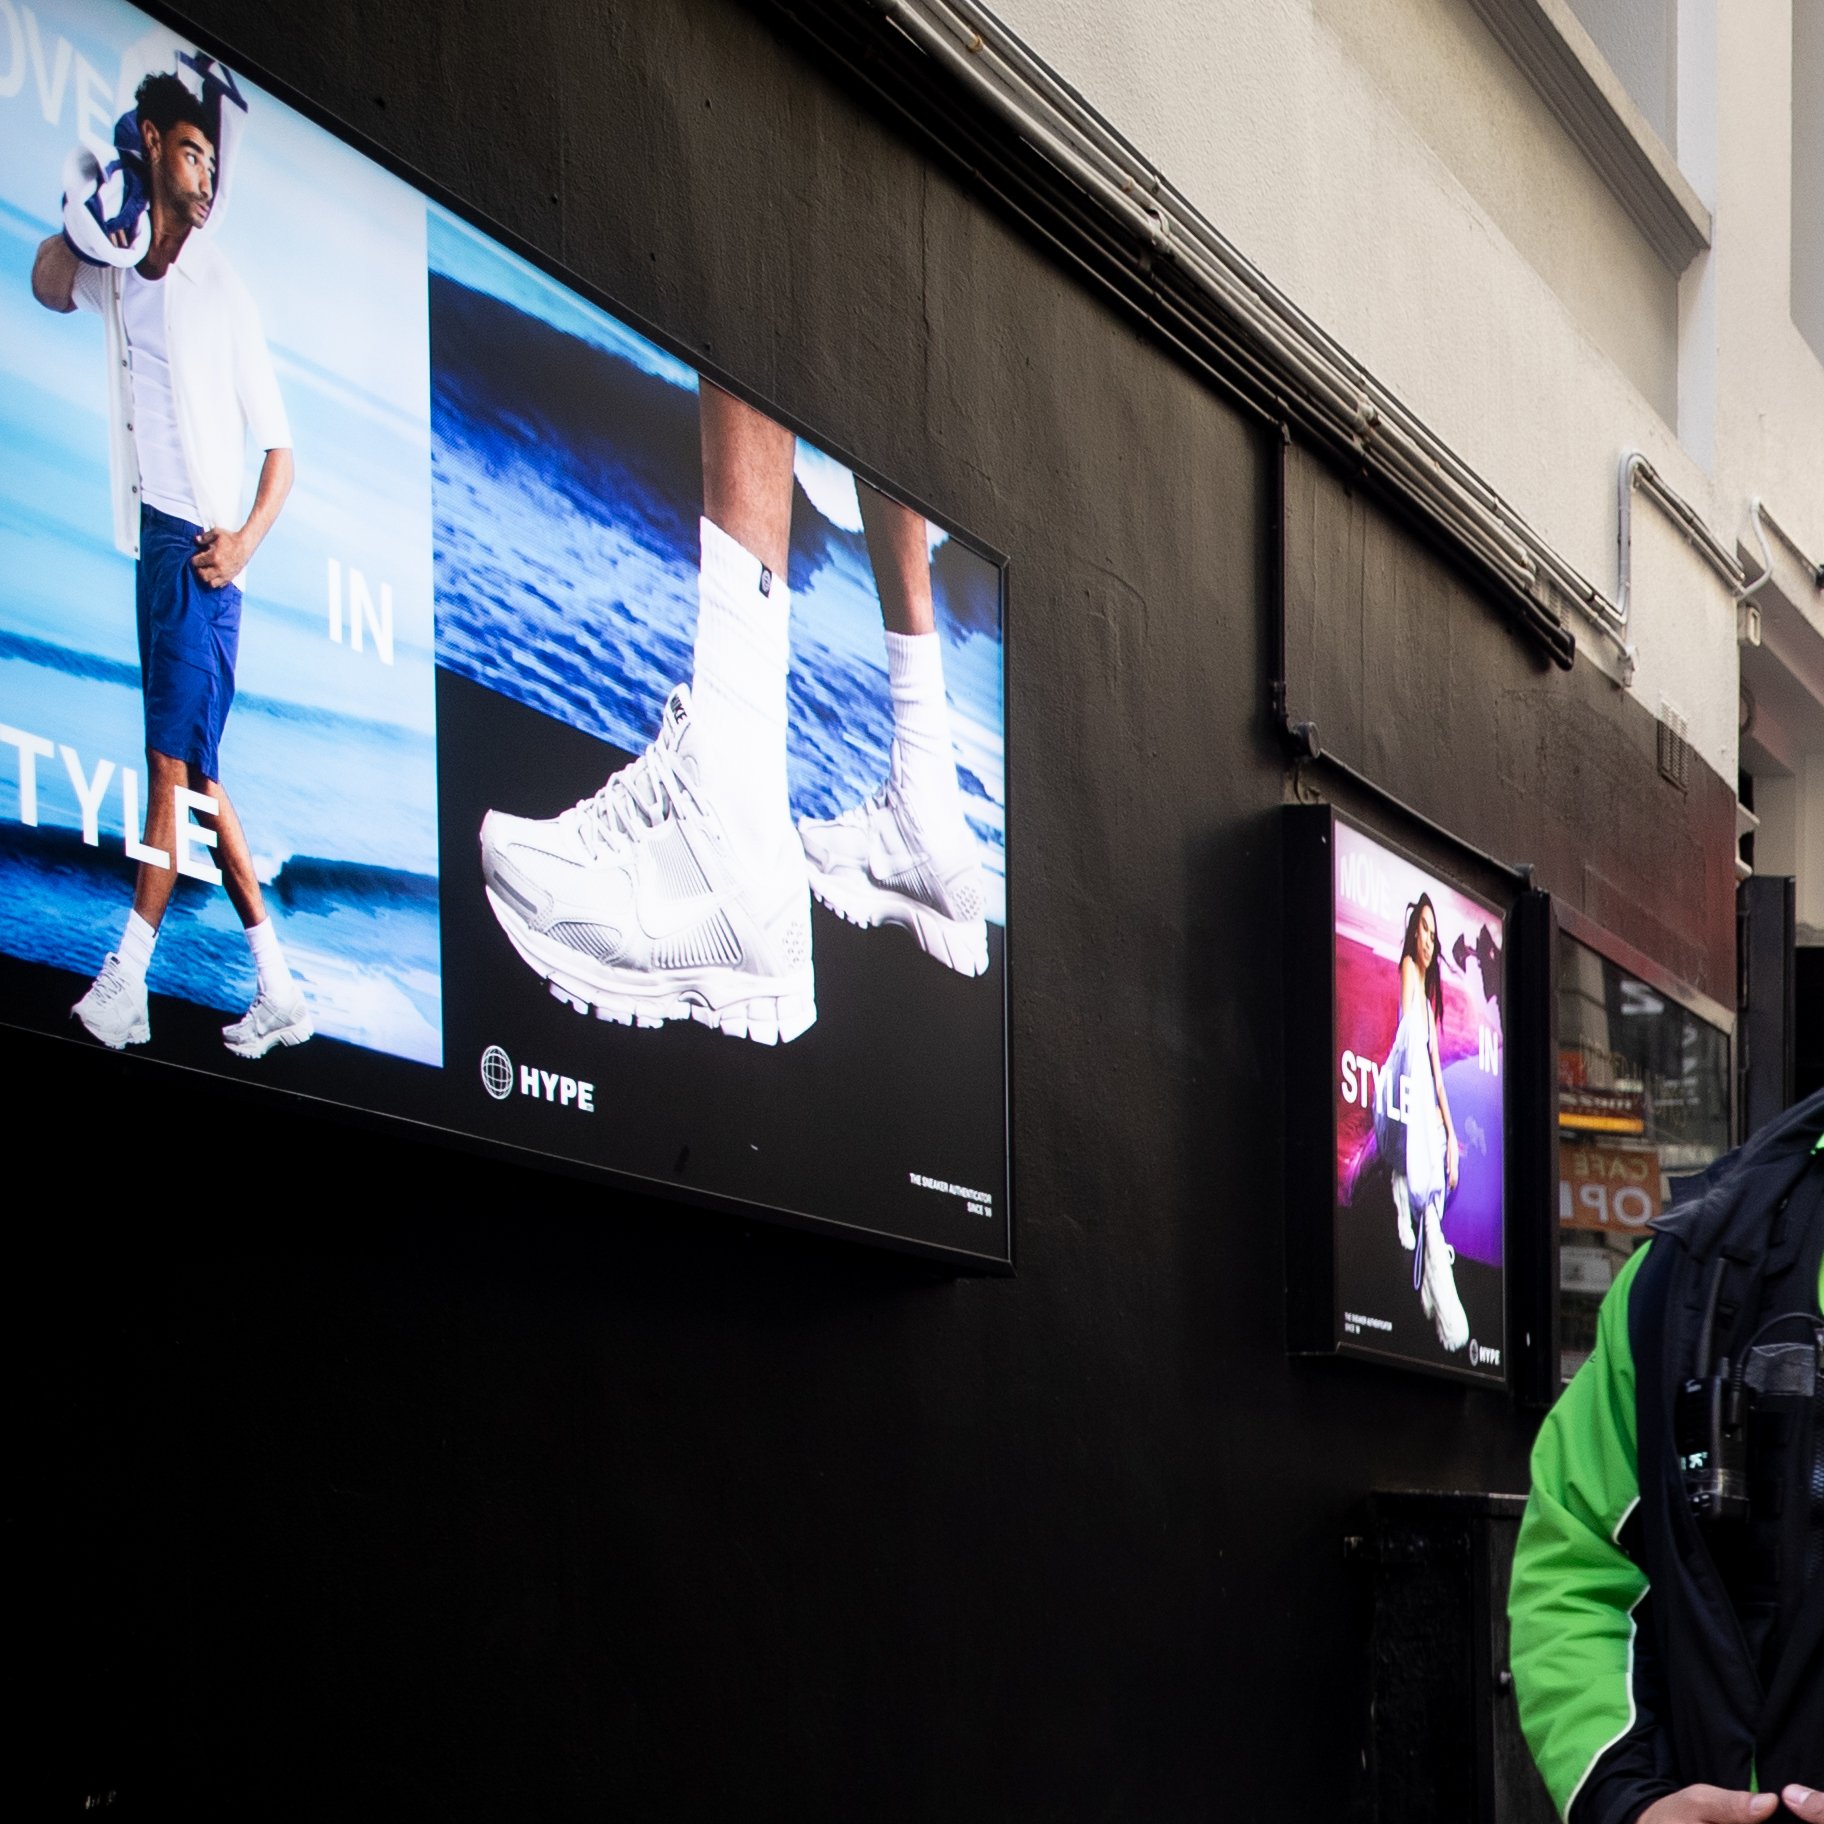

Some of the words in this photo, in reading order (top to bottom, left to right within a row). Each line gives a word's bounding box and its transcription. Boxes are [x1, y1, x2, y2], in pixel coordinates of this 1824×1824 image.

[327, 557, 395, 666] IN
[0, 722, 223, 887] TYLE
[1341, 1050, 1411, 1124] STYLE
[1478, 1024, 1498, 1076] IN
[520, 1065, 595, 1112] HYPE
